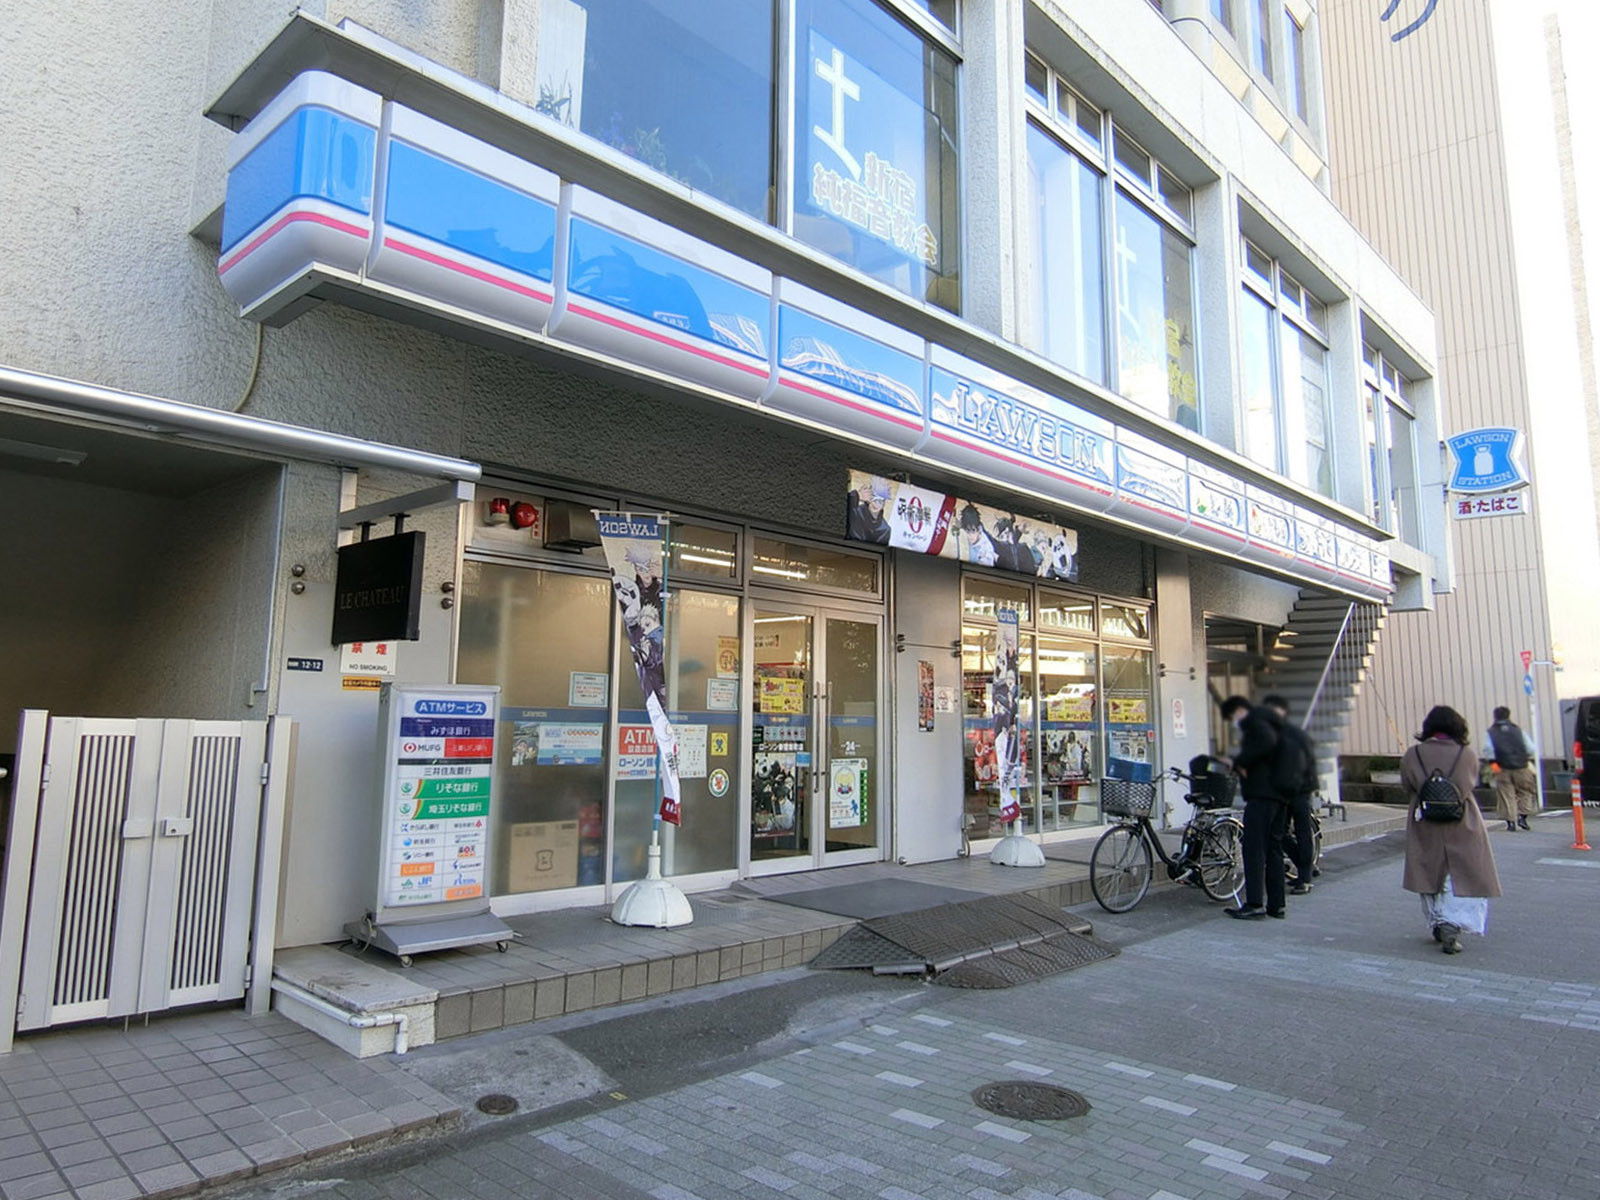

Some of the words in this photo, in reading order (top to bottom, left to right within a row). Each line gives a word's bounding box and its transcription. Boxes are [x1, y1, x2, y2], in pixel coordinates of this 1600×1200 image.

[864, 151, 917, 216] 新宿
[813, 161, 937, 265] 純福音教会
[957, 381, 1097, 475] LAWSON
[1454, 433, 1511, 449] LAWSON
[1457, 471, 1513, 486] STATION
[340, 592, 353, 610] LE
[360, 664, 388, 672] SMOKING
[418, 701, 483, 714] ATMサービス
[430, 726, 471, 736] みずほ銀行
[624, 729, 657, 744] ATM
[418, 744, 441, 752] MUFG
[424, 767, 472, 776] 三井住友銀行
[436, 782, 479, 794] りそな銀行
[428, 802, 482, 814] 埼玉りそな銀行
